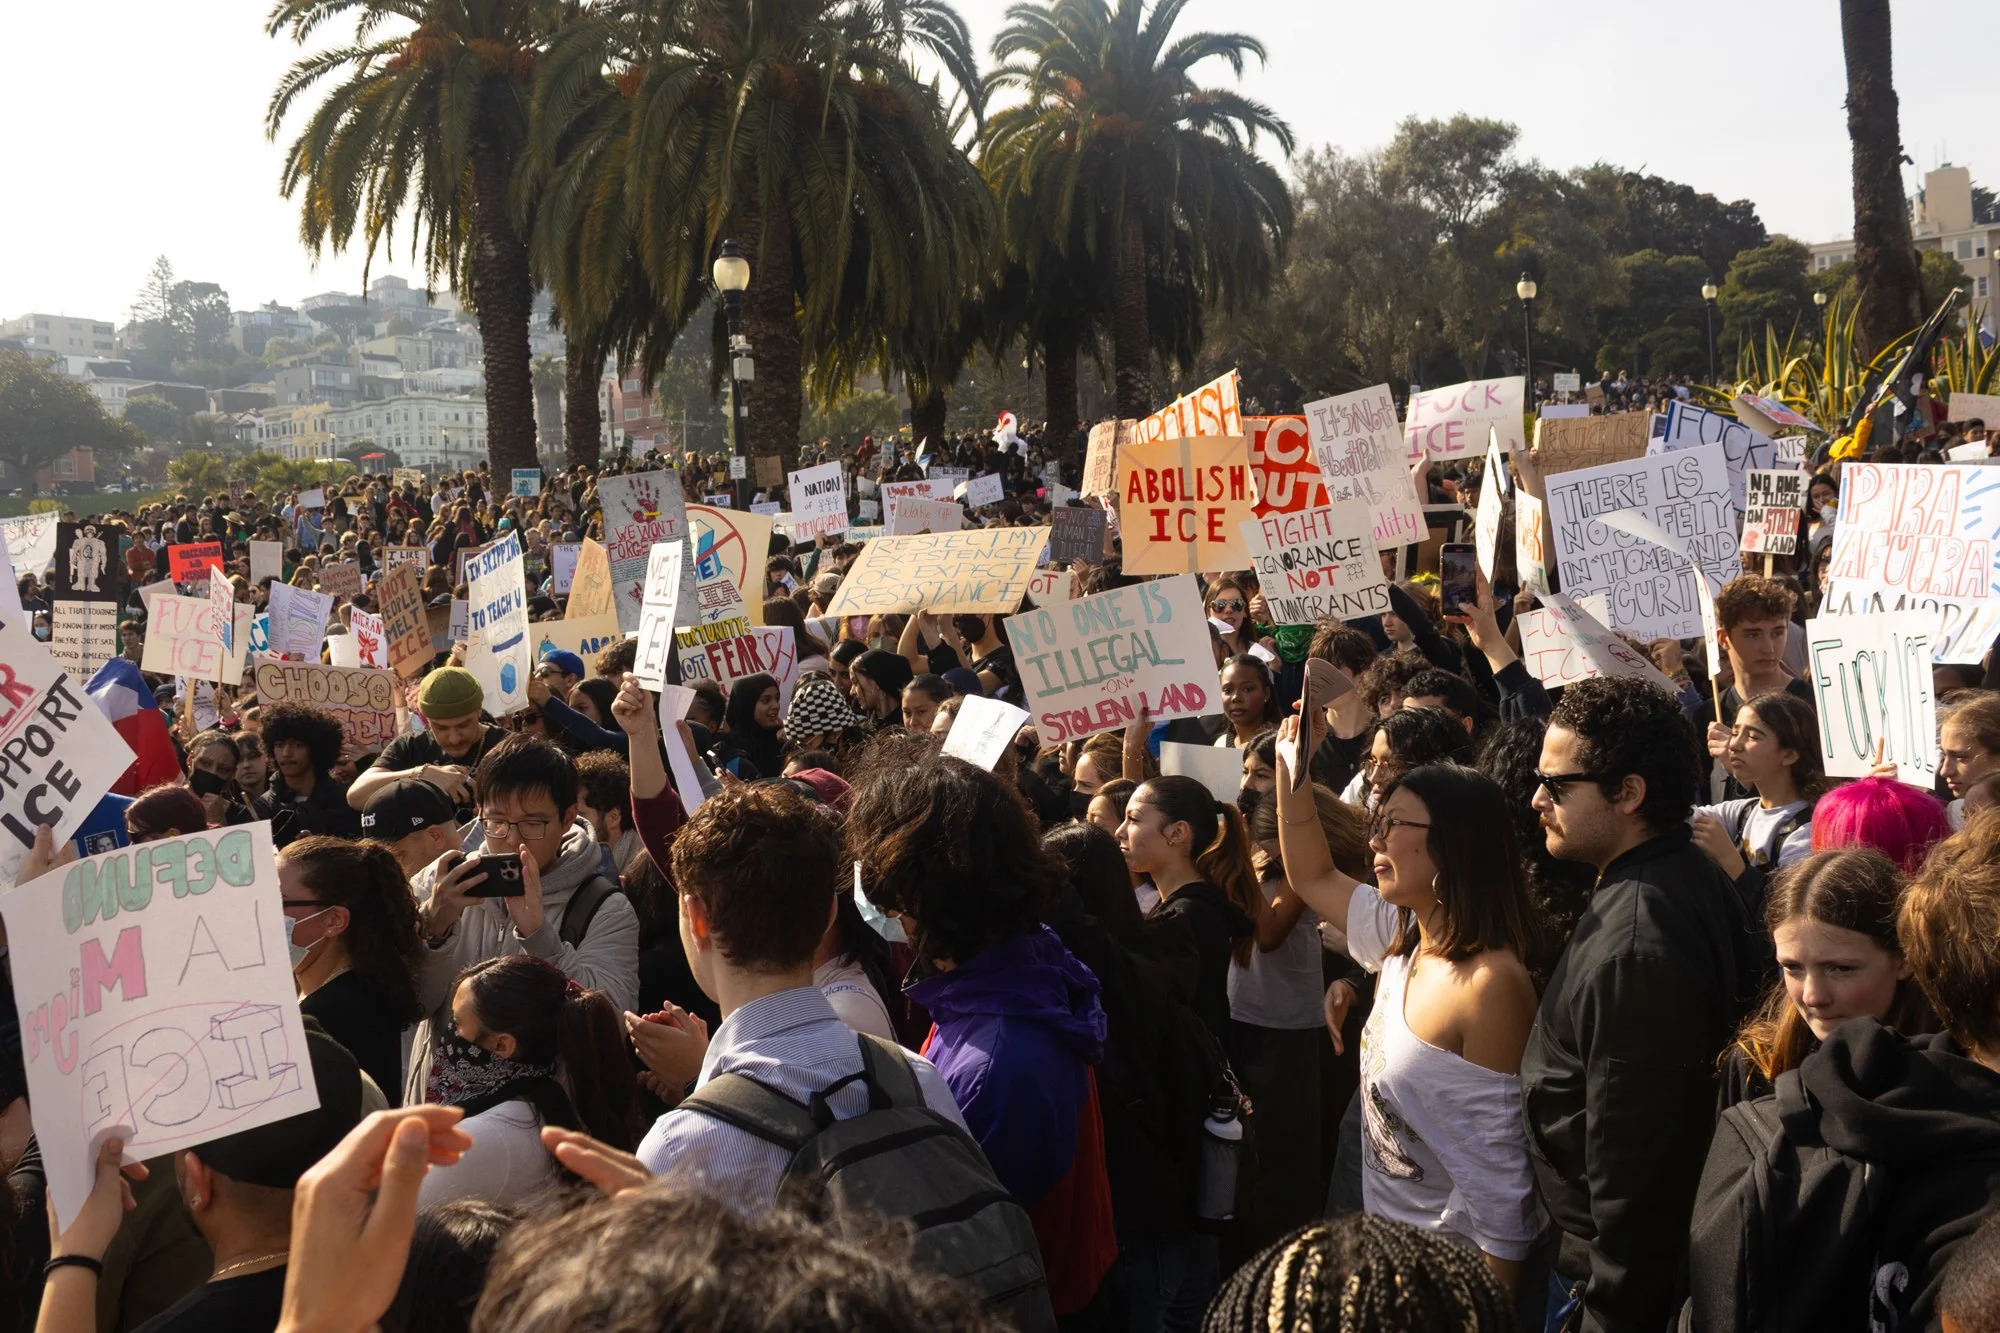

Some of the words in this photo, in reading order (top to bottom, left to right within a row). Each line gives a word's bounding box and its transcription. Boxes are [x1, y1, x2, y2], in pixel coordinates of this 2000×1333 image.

[1313, 405, 1353, 441] It's
[1351, 396, 1393, 433] Not
[1413, 383, 1502, 421] FUCK
[1407, 420, 1465, 458] ICE
[794, 474, 801, 484] A
[804, 475, 840, 497] NATION
[1127, 465, 1245, 504] ABOLISH
[1551, 471, 1649, 525] THERE
[1661, 456, 1704, 500] IS
[1750, 473, 1771, 492] NO
[1776, 475, 1800, 493] ONE
[1069, 511, 1085, 524] NO
[1748, 492, 1758, 506] IS
[1761, 492, 1800, 508] ILLEGAL
[1845, 463, 1961, 537] PARA
[614, 524, 634, 541] WE
[795, 512, 849, 539] IMMIGRANTS
[1008, 528, 1045, 547] MY
[1053, 523, 1084, 540] HUMAN
[1088, 526, 1097, 543] IS
[1149, 507, 1226, 543] ICE
[1261, 508, 1333, 550] FIGHT
[1373, 506, 1418, 543] ality
[1561, 517, 1609, 555] NO
[1613, 489, 1732, 549] FETY
[1747, 508, 1764, 524] ON
[1764, 508, 1801, 536] STOLEN
[388, 551, 396, 560] I
[400, 551, 420, 559] LIKE
[482, 533, 521, 576] SKIPPING
[608, 539, 661, 562] FORGE
[866, 547, 1035, 568] EXISTENCE
[1252, 537, 1362, 576] IGNORANCE
[1763, 535, 1795, 554] LAND
[856, 567, 901, 587] OR
[914, 562, 1030, 580] EXPECT
[1286, 564, 1342, 595] NOT
[1562, 557, 1592, 588] IN
[1830, 530, 1989, 599] AFUERA
[380, 569, 408, 604] HOT
[836, 580, 1024, 613] RESISTANCE
[1267, 583, 1390, 625] IMMIGRANTS
[1825, 581, 1854, 617] LA
[54, 606, 66, 615] ALL
[69, 606, 86, 615] THAT
[153, 598, 247, 635] FUC
[381, 587, 417, 624] PEOPLE
[472, 608, 485, 631] TO
[487, 594, 512, 624] TEACH
[514, 588, 522, 609] U
[1006, 610, 1057, 657] NO
[1072, 591, 1135, 637] ONE
[1137, 582, 1173, 624] IS
[54, 635, 79, 645] THEY'RE
[81, 637, 99, 645] JUST
[385, 607, 419, 645] MELT
[1667, 619, 1694, 639] ICE
[53, 649, 79, 659] SCARED
[167, 637, 223, 674] ICE
[390, 626, 430, 665] ICE
[704, 634, 767, 682] FEAR
[1025, 629, 1186, 698] ILLEGAL
[1105, 678, 1130, 694] ON
[1812, 638, 1893, 767] FUCK
[1041, 695, 1136, 742] STOLEN
[1138, 682, 1207, 717] LAND
[0, 672, 84, 802] PPORT
[0, 759, 82, 851] ICE
